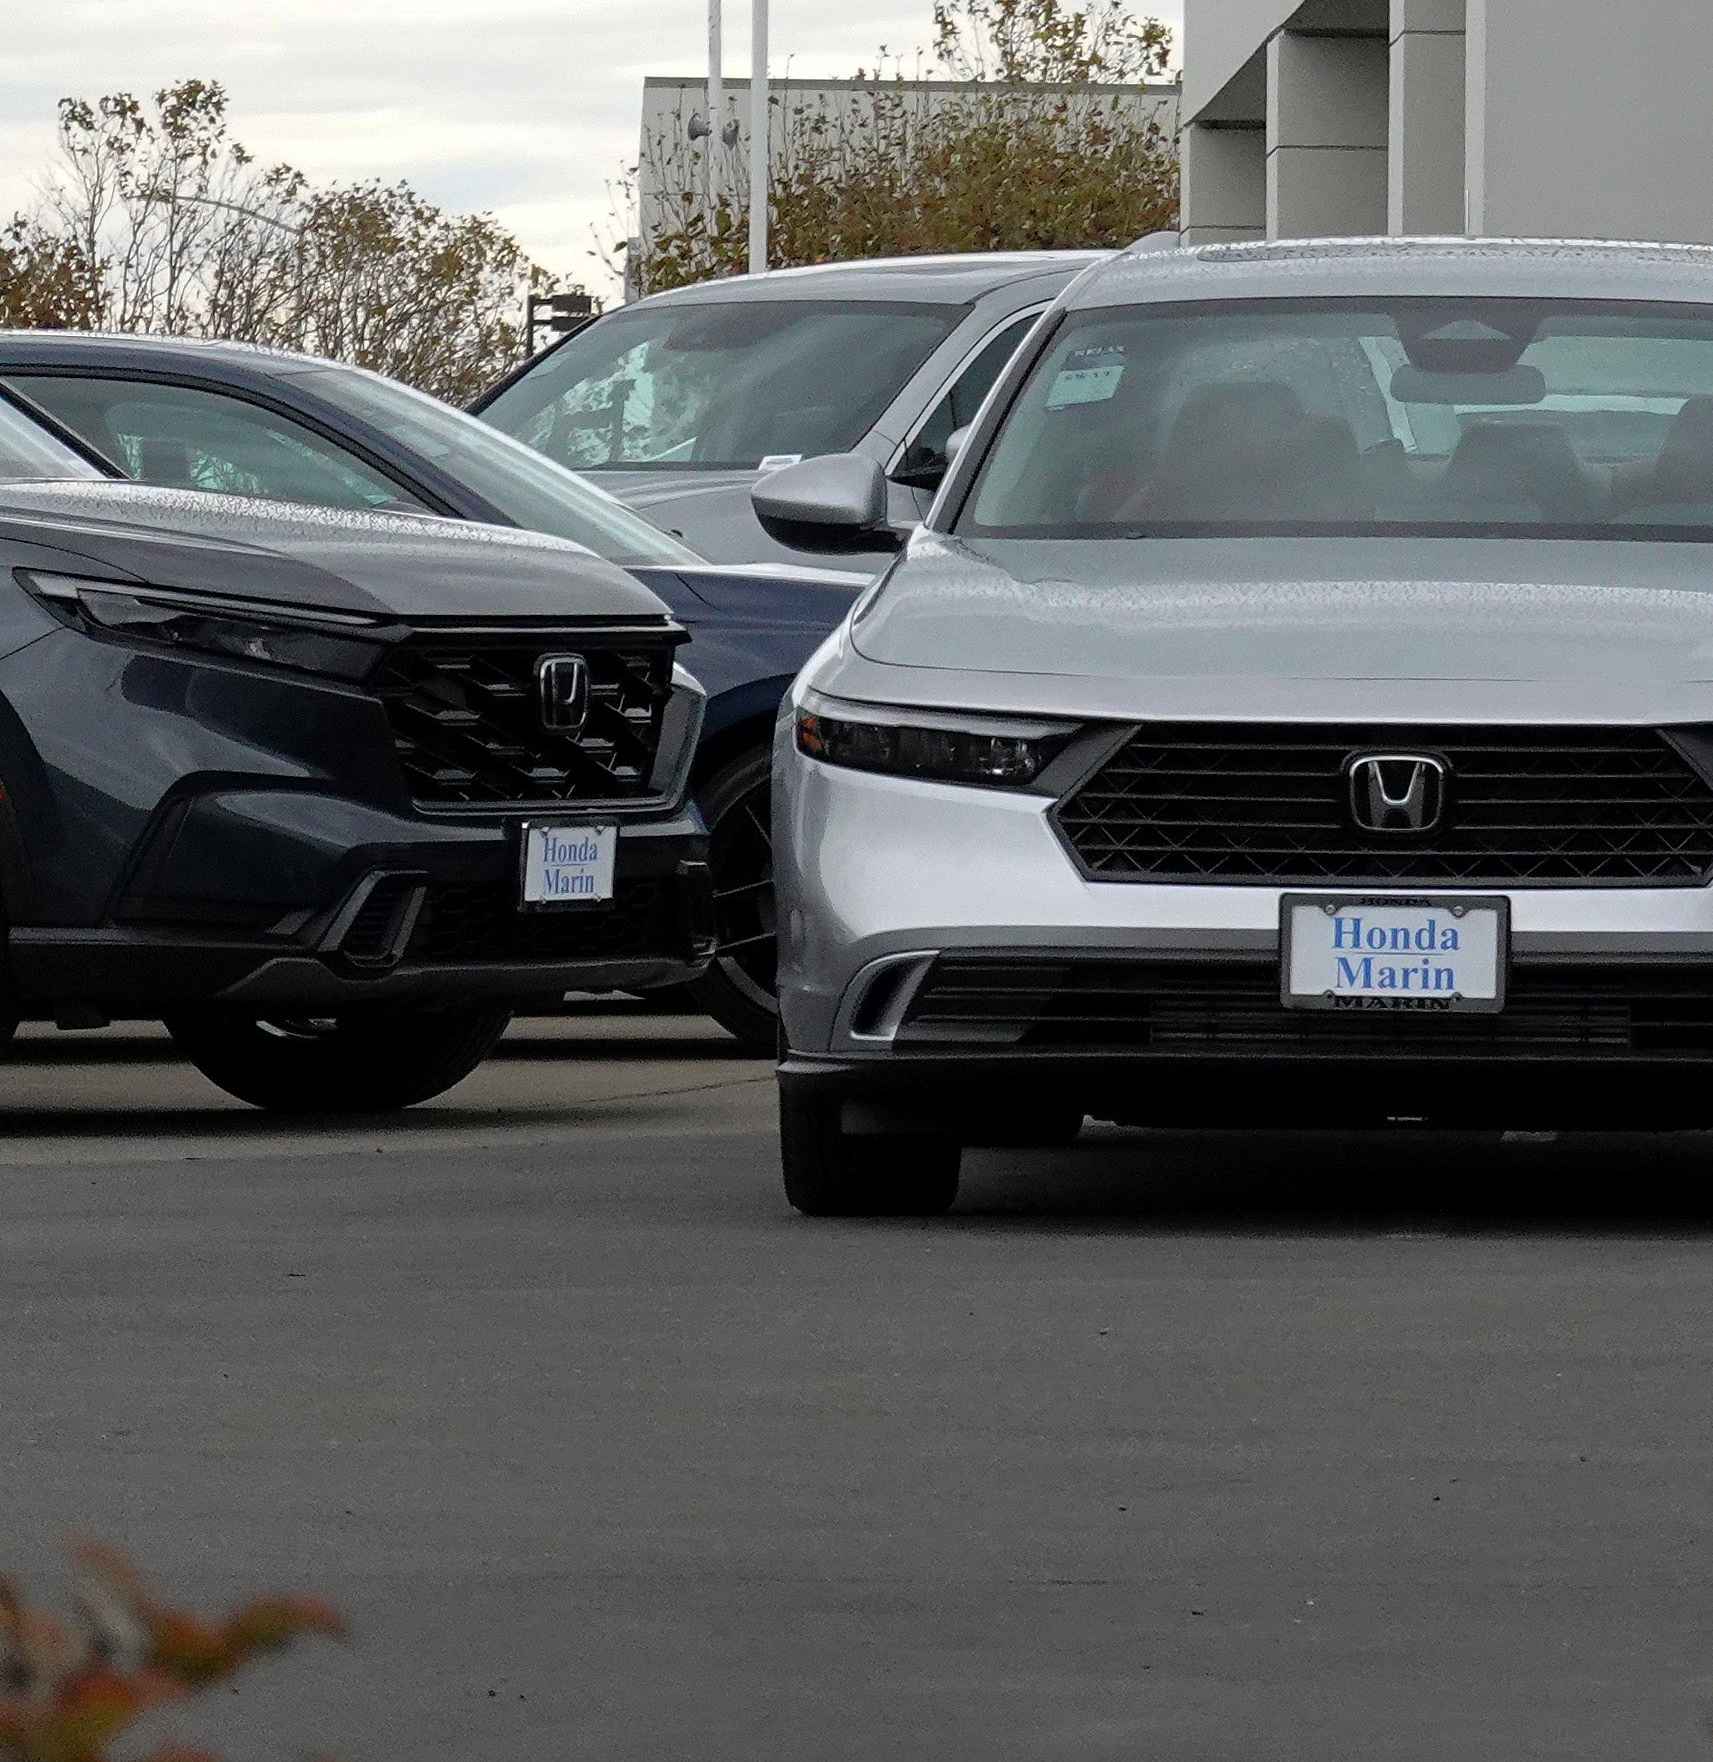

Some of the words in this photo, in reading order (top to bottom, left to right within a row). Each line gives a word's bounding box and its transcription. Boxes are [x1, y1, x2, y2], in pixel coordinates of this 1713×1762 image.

[543, 836, 599, 863] Honda
[544, 868, 595, 895] Marin
[1330, 917, 1461, 951] Honda
[1333, 956, 1456, 991] Marin
